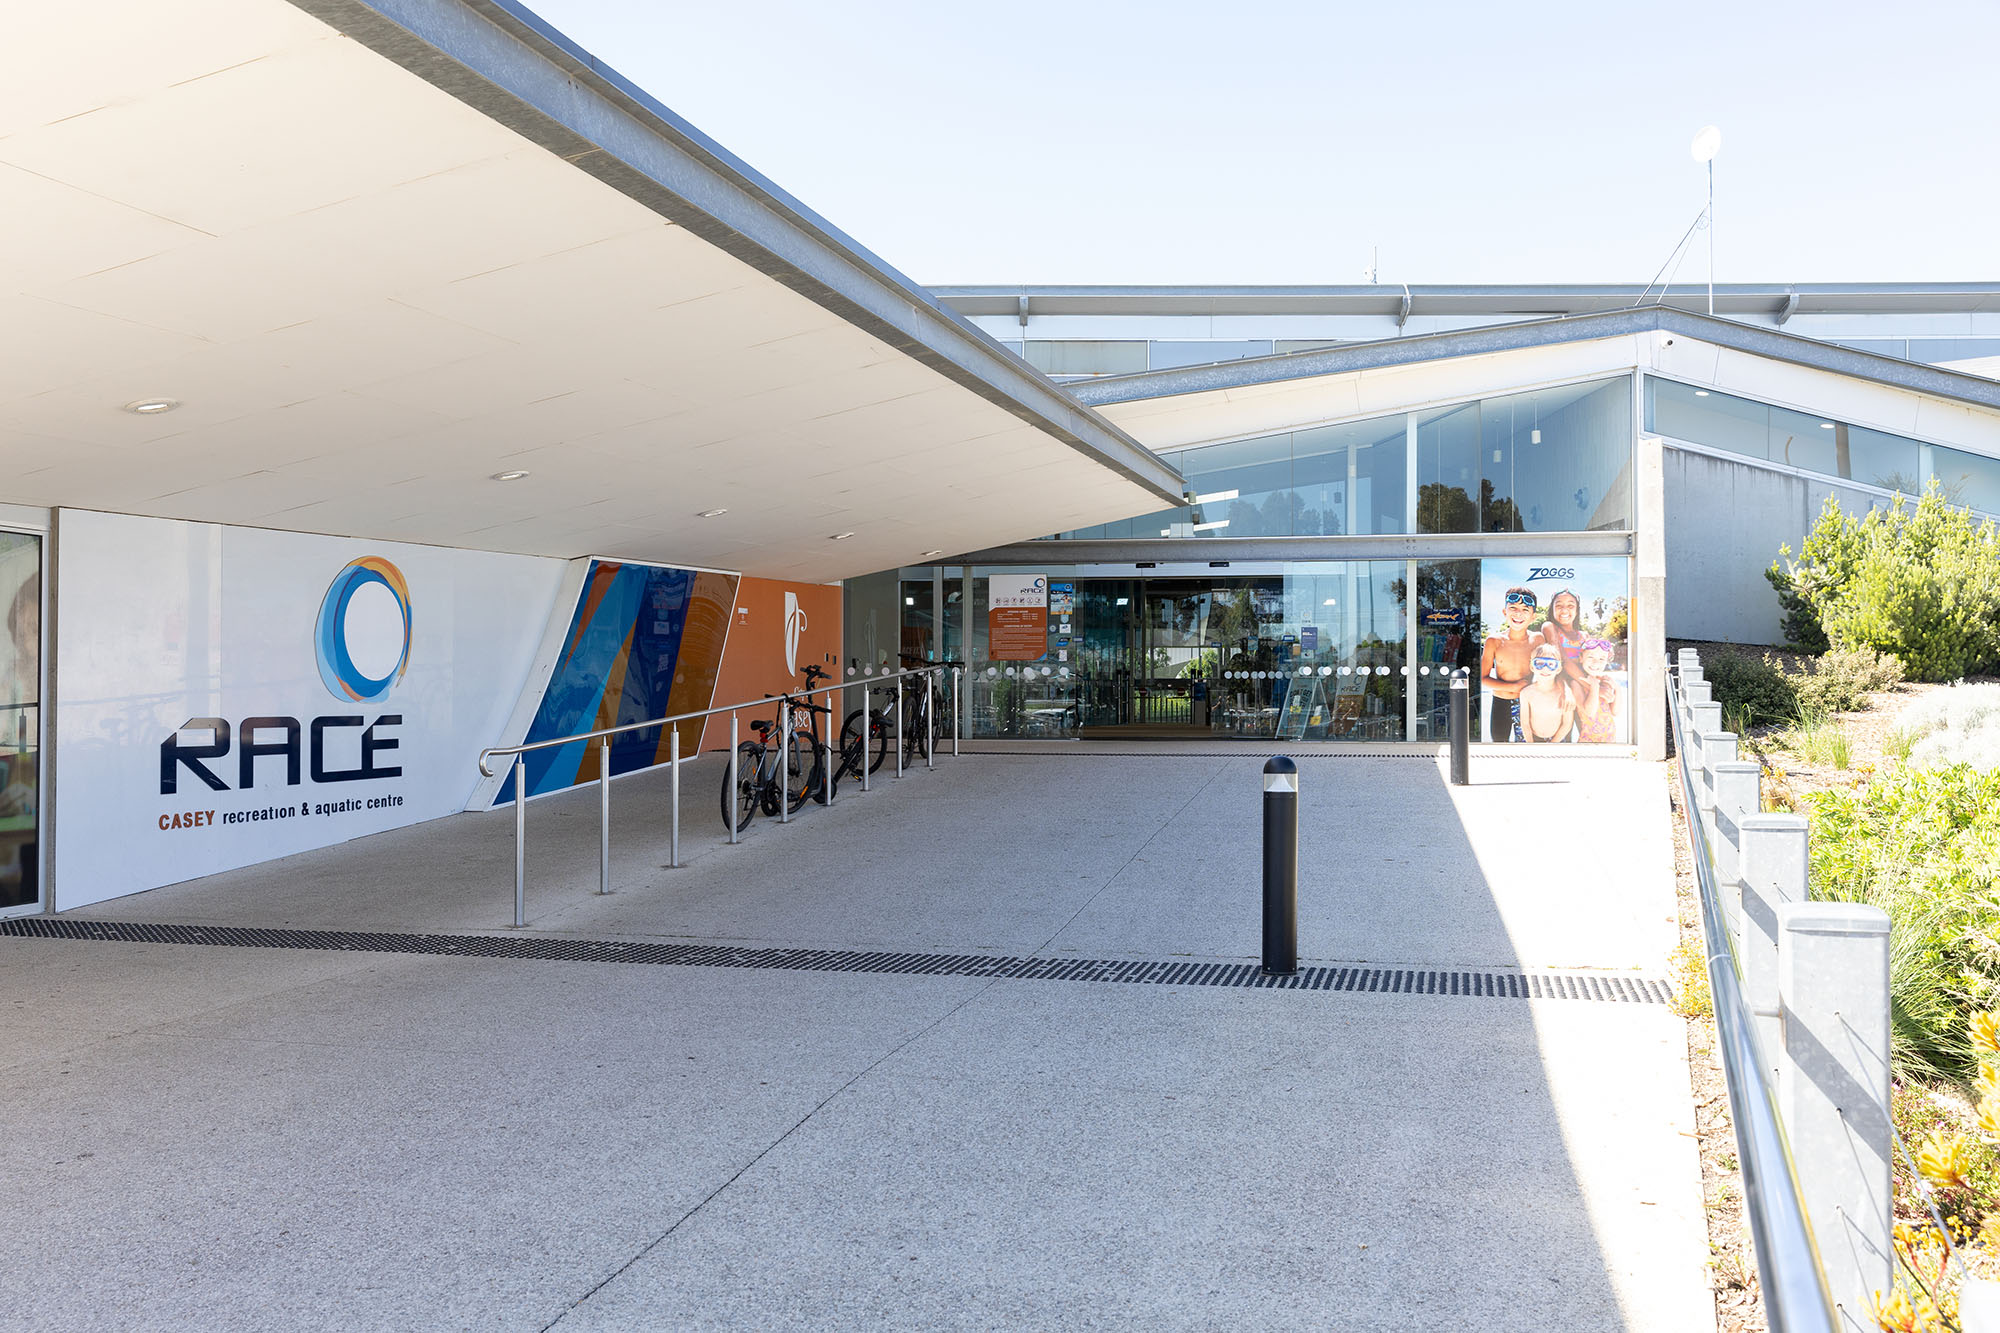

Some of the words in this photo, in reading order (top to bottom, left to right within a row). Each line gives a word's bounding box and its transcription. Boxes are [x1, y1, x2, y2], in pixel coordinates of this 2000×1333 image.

[1526, 567, 1575, 582] ZOGGS
[793, 710, 812, 733] asey
[160, 715, 402, 795] RACE
[158, 810, 215, 830] CASEY
[223, 805, 295, 824] recreation
[301, 802, 309, 816] &
[315, 798, 362, 816] aquatic
[367, 794, 403, 809] centre
